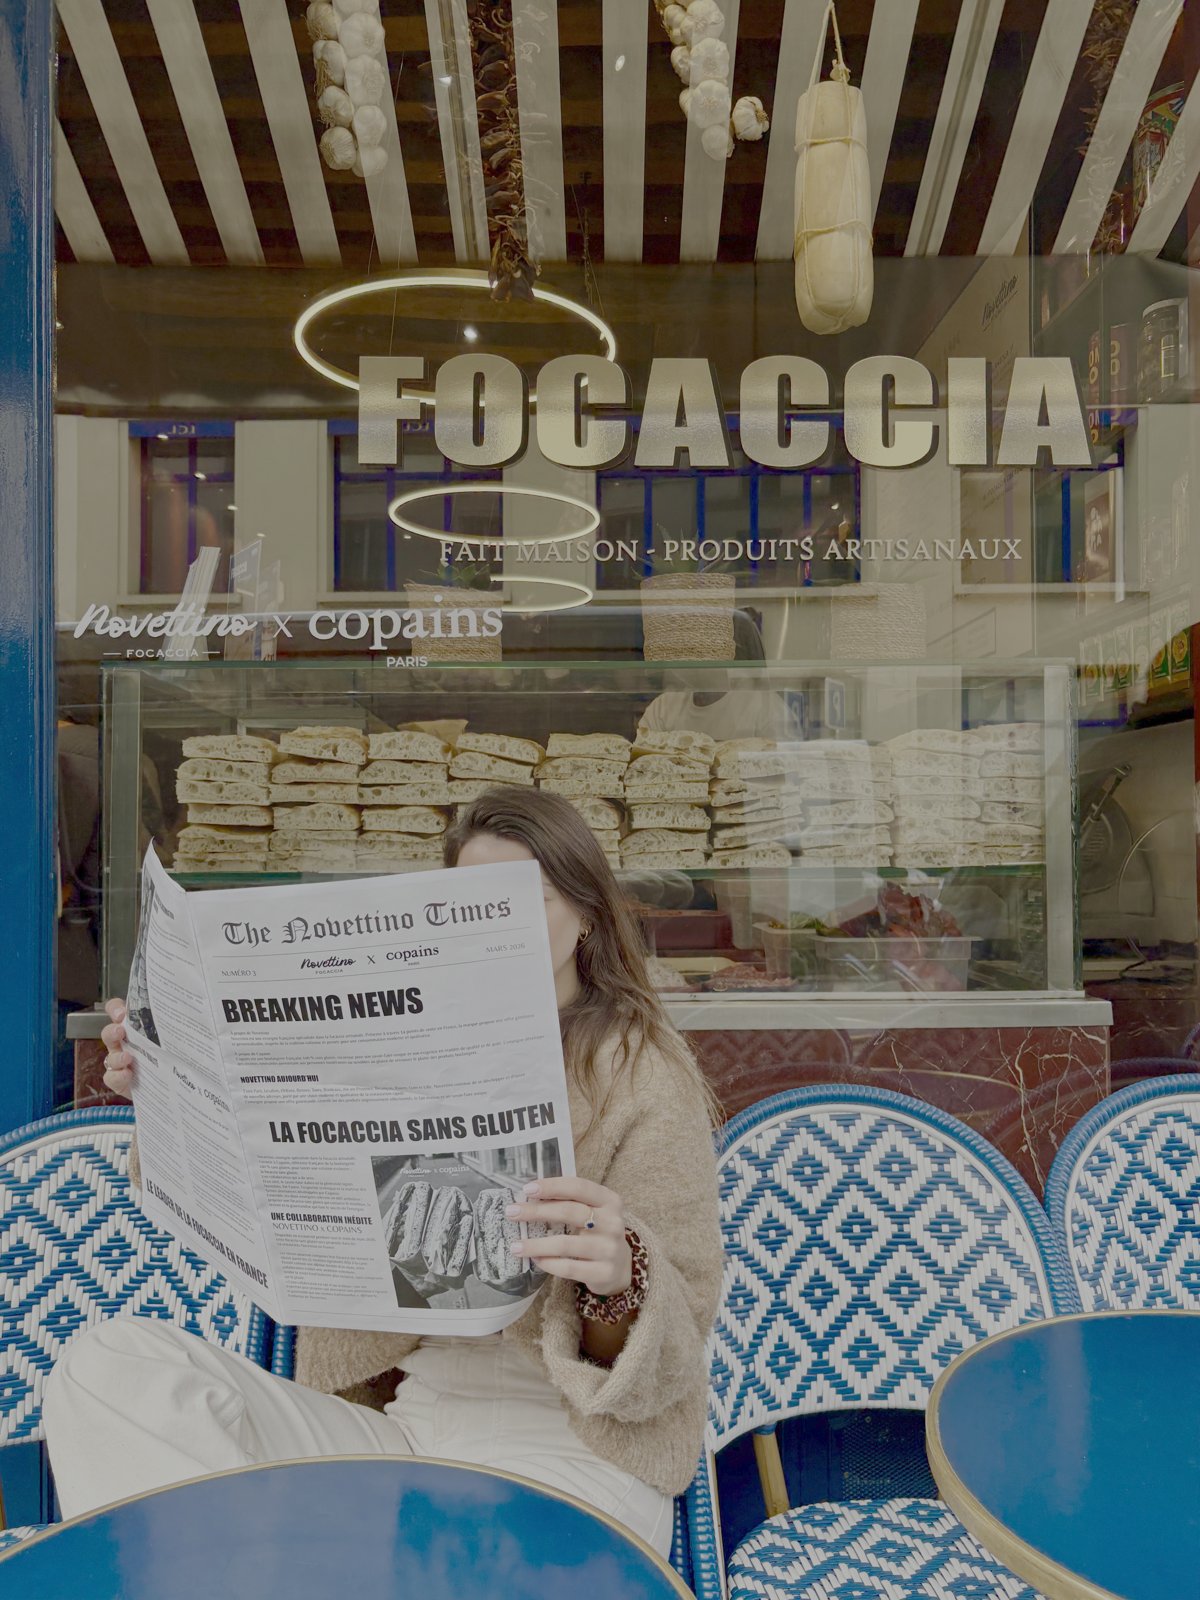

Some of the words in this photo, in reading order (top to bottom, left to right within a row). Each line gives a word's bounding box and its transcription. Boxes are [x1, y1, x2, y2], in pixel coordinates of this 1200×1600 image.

[358, 353, 1093, 468] FOCACCIA
[439, 540, 503, 562] FAIT
[515, 539, 639, 562] MAISON
[663, 538, 814, 562] PRODUITS
[822, 538, 1022, 561] ARTISANAUX
[308, 594, 504, 650] copains
[126, 648, 199, 658] FOCACCIA
[386, 656, 429, 668] PARIS
[221, 921, 272, 948] The
[281, 910, 414, 944] Novettino
[423, 897, 511, 927] Times
[385, 945, 439, 962] copains
[485, 945, 508, 953] MARS
[221, 994, 344, 1023] BREAKING
[347, 987, 424, 1019] NEWS
[240, 1075, 276, 1084] NOVETTINO
[269, 1121, 295, 1143] LA
[297, 1120, 404, 1144] FOCACCIA
[407, 1115, 469, 1142] SANS
[471, 1101, 556, 1138] GLUTEN
[270, 1212, 285, 1221] UNE
[286, 1212, 343, 1224] COLLABORATION
[344, 1214, 373, 1225] INÉDITE
[272, 1222, 319, 1232] NOVETTINO
[326, 1225, 363, 1234] COPAINS
[153, 1183, 175, 1213] LEADER
[191, 1218, 227, 1257] FOCACCIA
[236, 1254, 269, 1289] FRANCE
